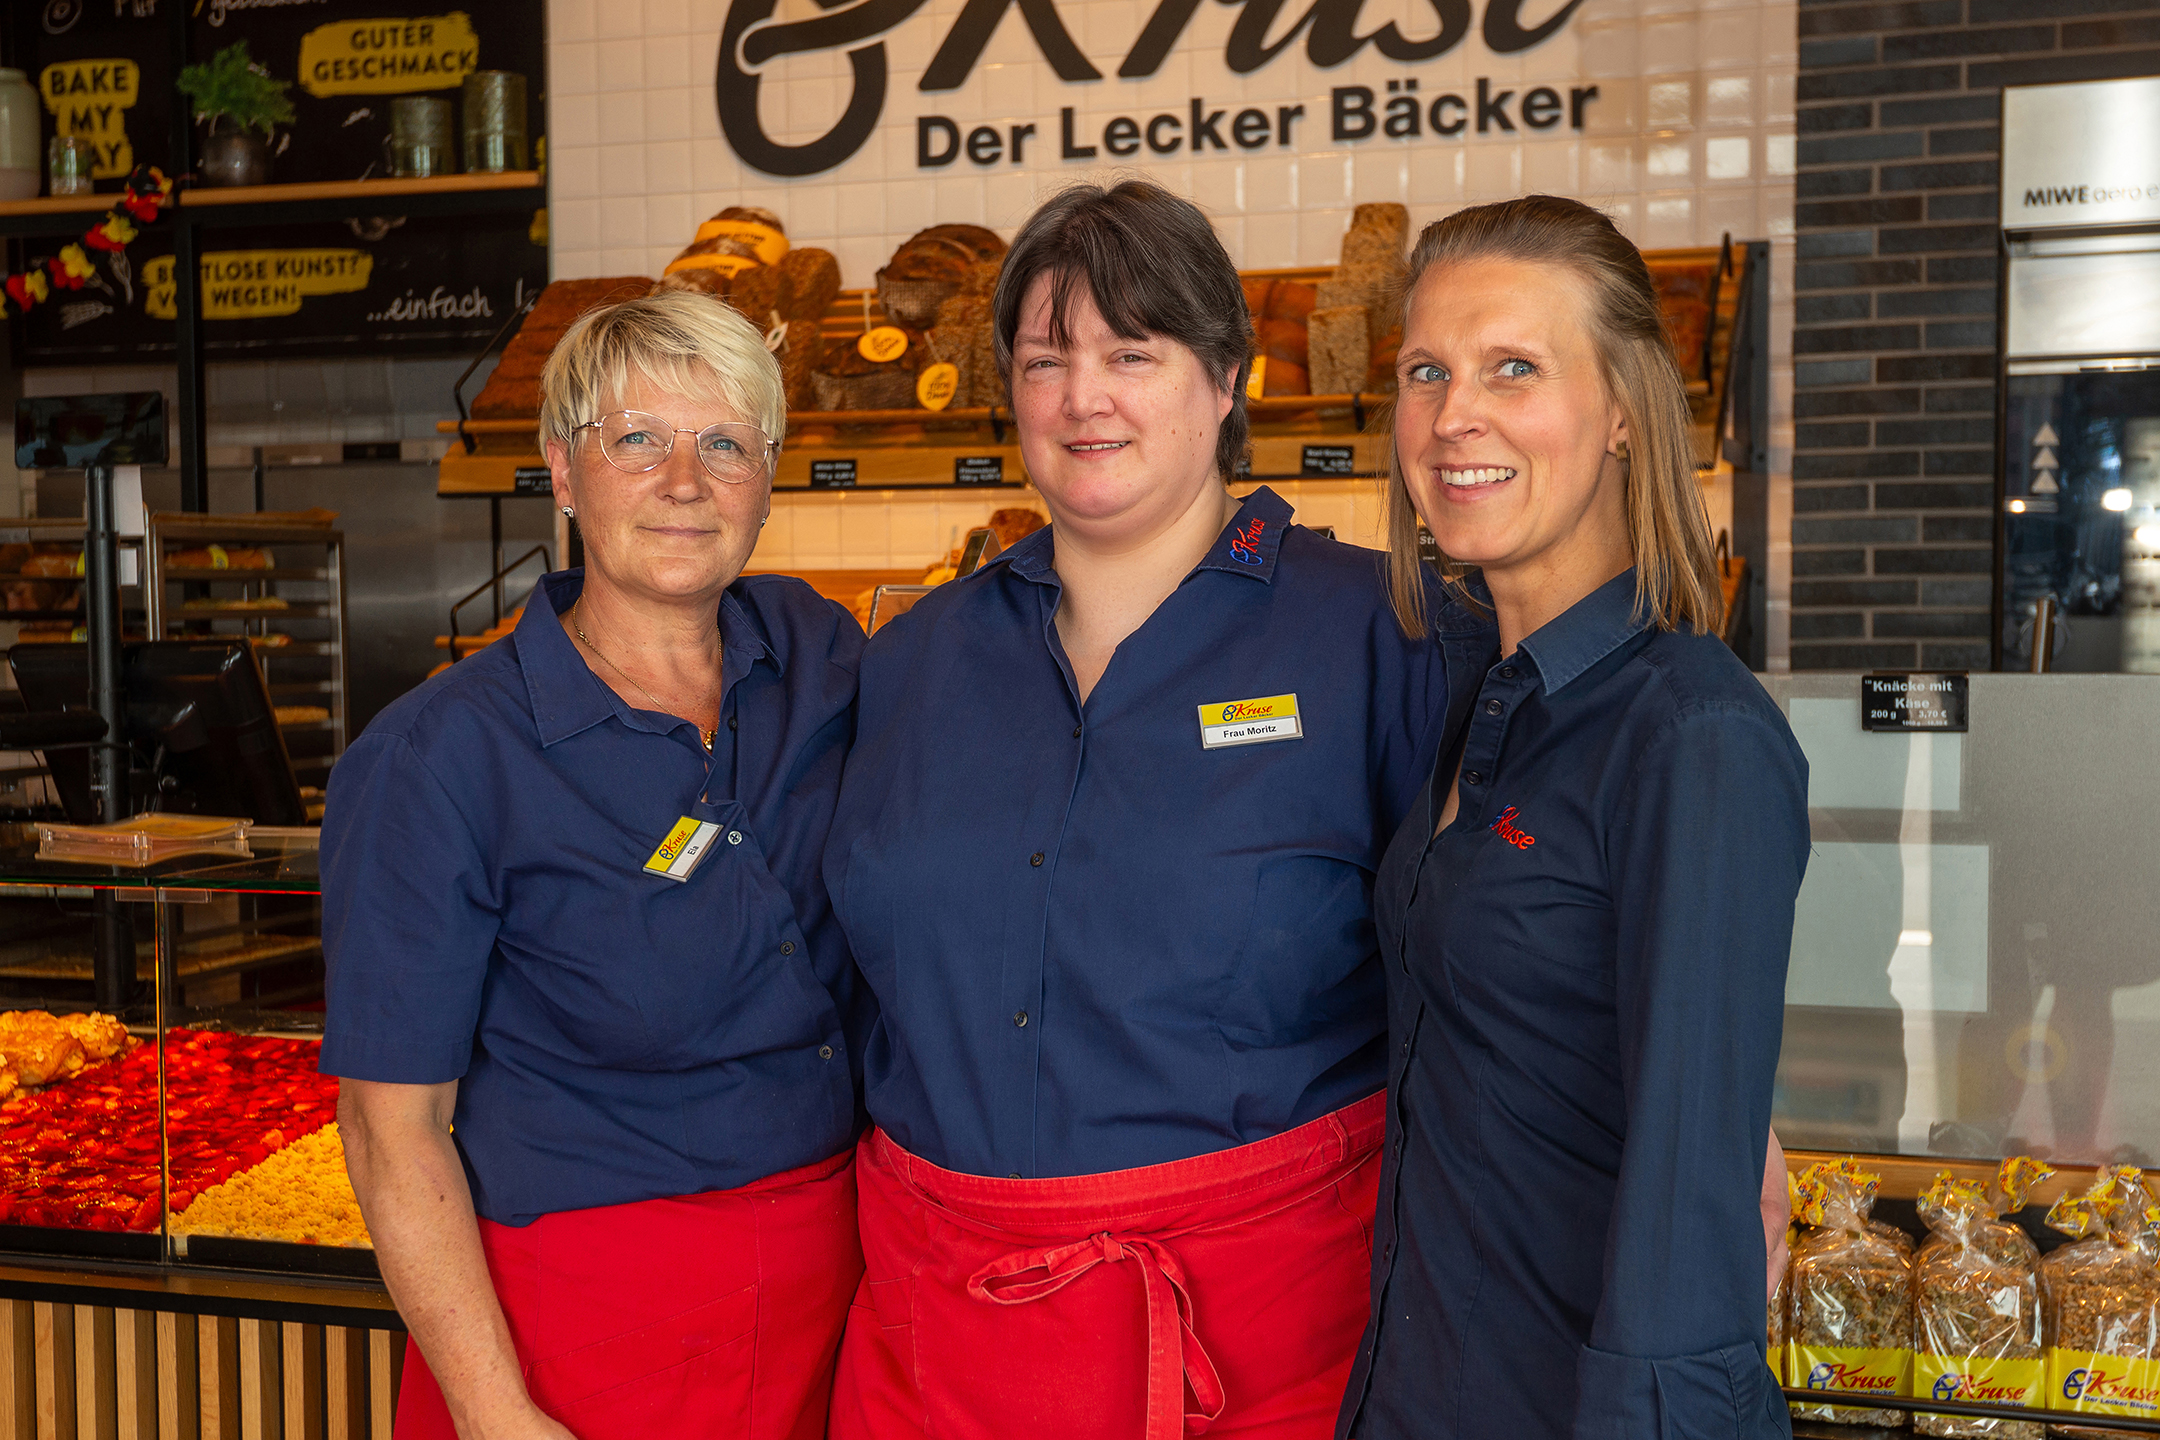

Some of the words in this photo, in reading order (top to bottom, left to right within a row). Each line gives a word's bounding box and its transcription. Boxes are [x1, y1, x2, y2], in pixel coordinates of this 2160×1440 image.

[351, 23, 434, 50] GUTER
[313, 51, 475, 81] GESCHMACK
[51, 65, 128, 95] BAKE
[70, 104, 113, 133] MY
[917, 114, 1036, 168] Der
[1060, 97, 1305, 160] Lecker
[1331, 76, 1598, 141] Bäcker
[2023, 184, 2089, 207] MIWE
[157, 259, 267, 284] BTLOSE
[276, 254, 359, 279] KUNST?
[211, 285, 297, 307] WEGEN!
[1929, 680, 1953, 692] mit
[1232, 702, 1273, 717] Kruse
[1871, 709, 1889, 718] 200
[1890, 711, 1897, 720] g
[1919, 710, 1939, 719] 3,70
[1941, 710, 1947, 718] €
[1895, 698, 1930, 709] Käse
[1223, 729, 1245, 739] Frau
[1247, 725, 1277, 736] Moritz
[1490, 806, 1535, 850] Kruse
[661, 829, 687, 853] Kruse
[687, 845, 699, 856] Ela
[1826, 1363, 1896, 1388] Kruse
[1952, 1374, 2027, 1400] Kruse
[2084, 1370, 2159, 1401] Kruse
